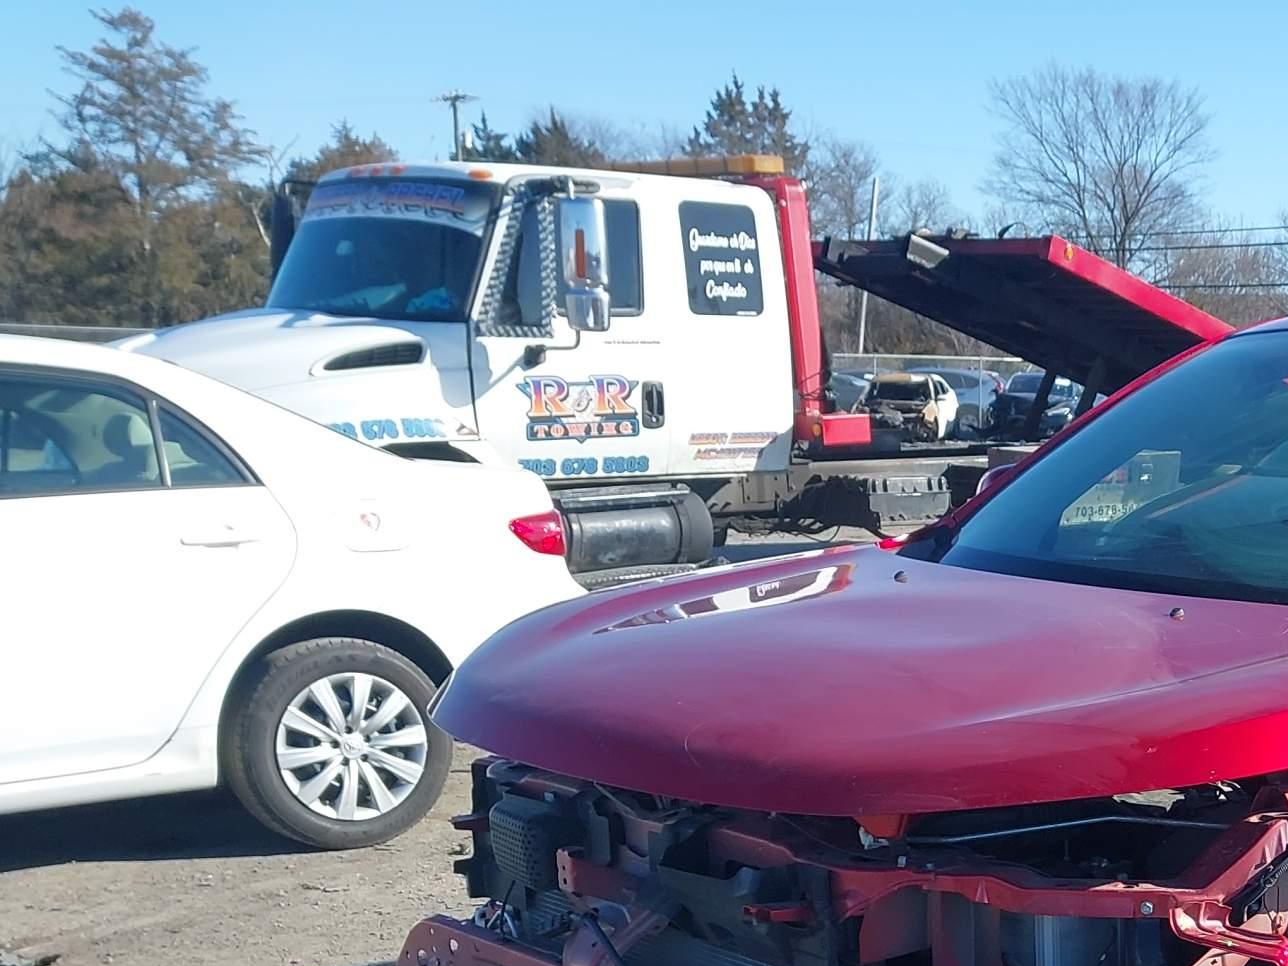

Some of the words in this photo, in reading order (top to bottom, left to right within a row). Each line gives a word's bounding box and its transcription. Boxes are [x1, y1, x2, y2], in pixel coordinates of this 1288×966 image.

[706, 279, 747, 302] Confiado
[533, 421, 633, 438] TOWING
[561, 457, 598, 476] 678
